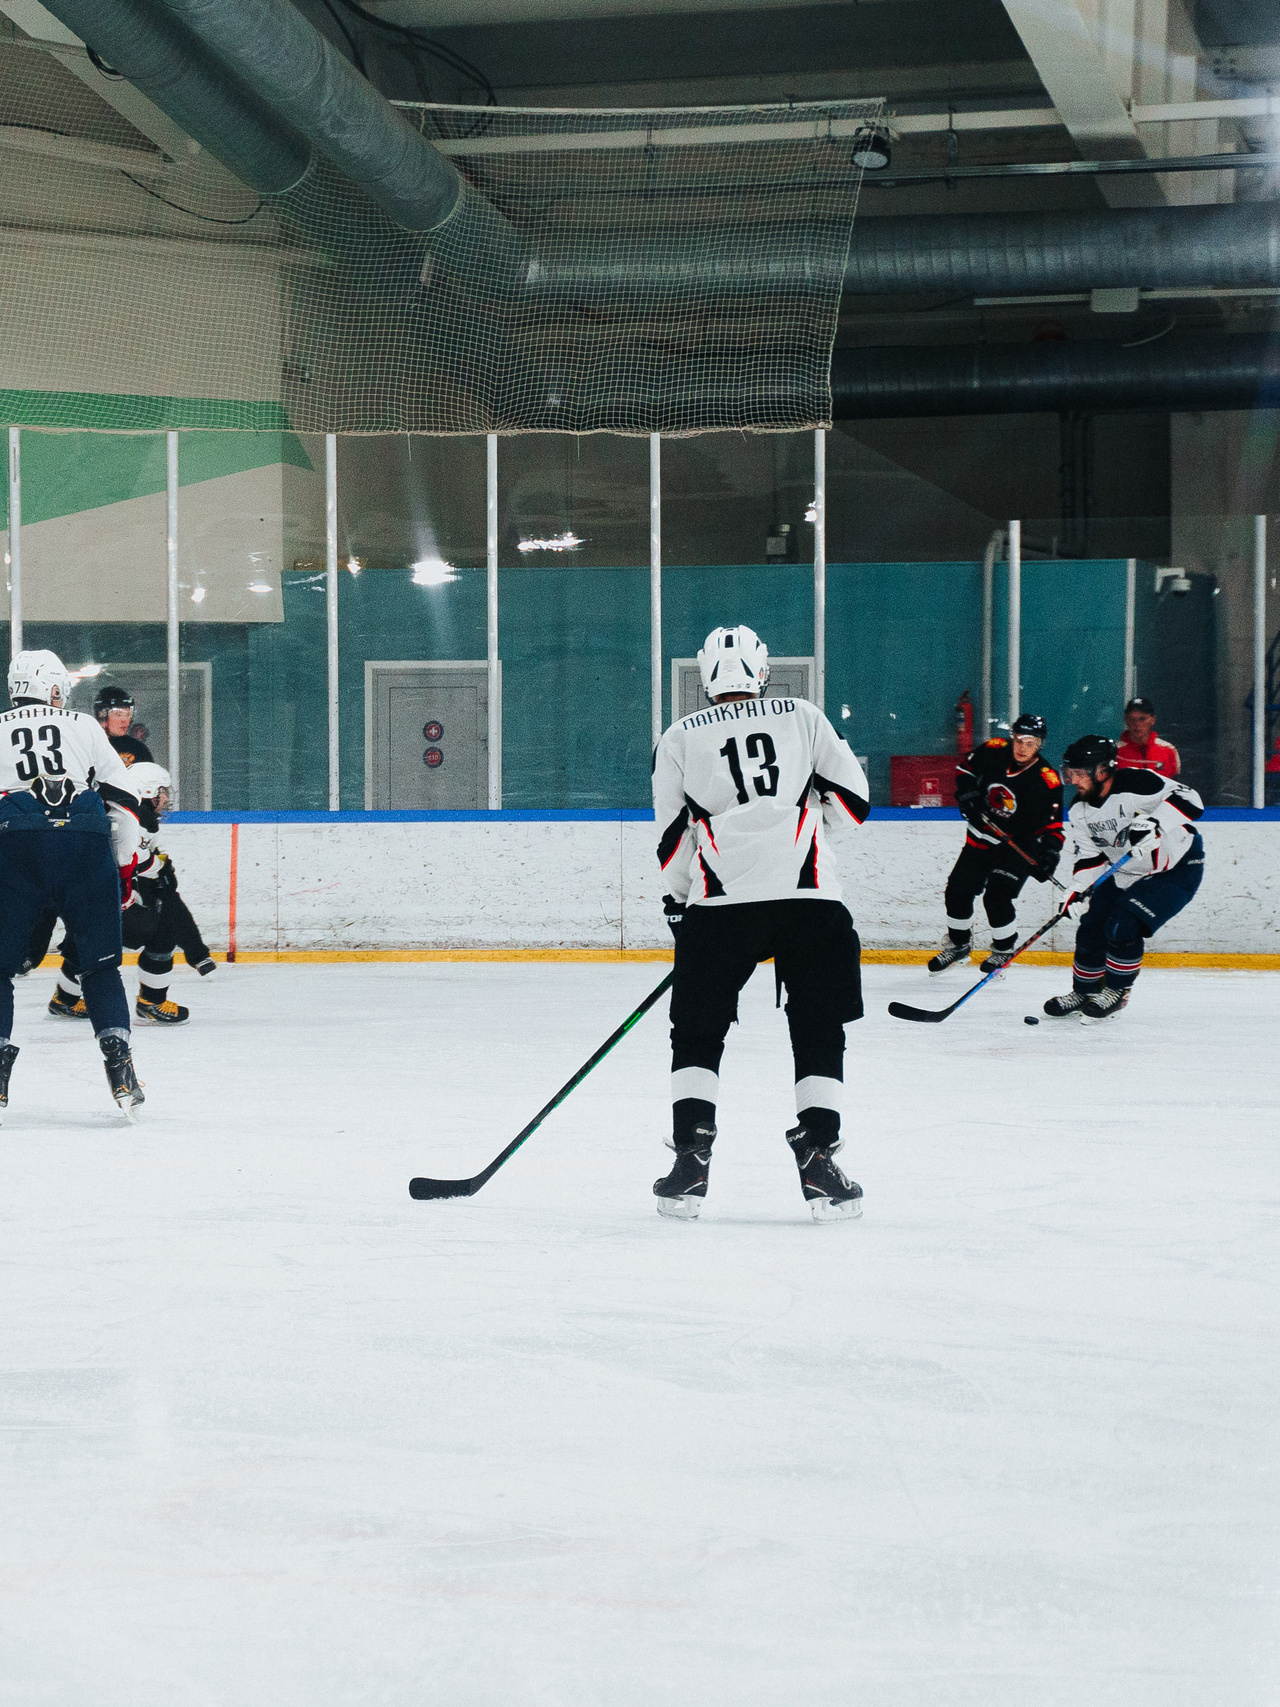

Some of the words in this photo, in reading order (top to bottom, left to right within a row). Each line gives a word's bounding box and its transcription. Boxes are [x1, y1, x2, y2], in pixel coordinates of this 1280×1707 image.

[14, 681, 29, 694] 77
[683, 699, 795, 730] ПАНКРАТОВ
[11, 725, 66, 781] 33
[719, 732, 780, 805] 13
